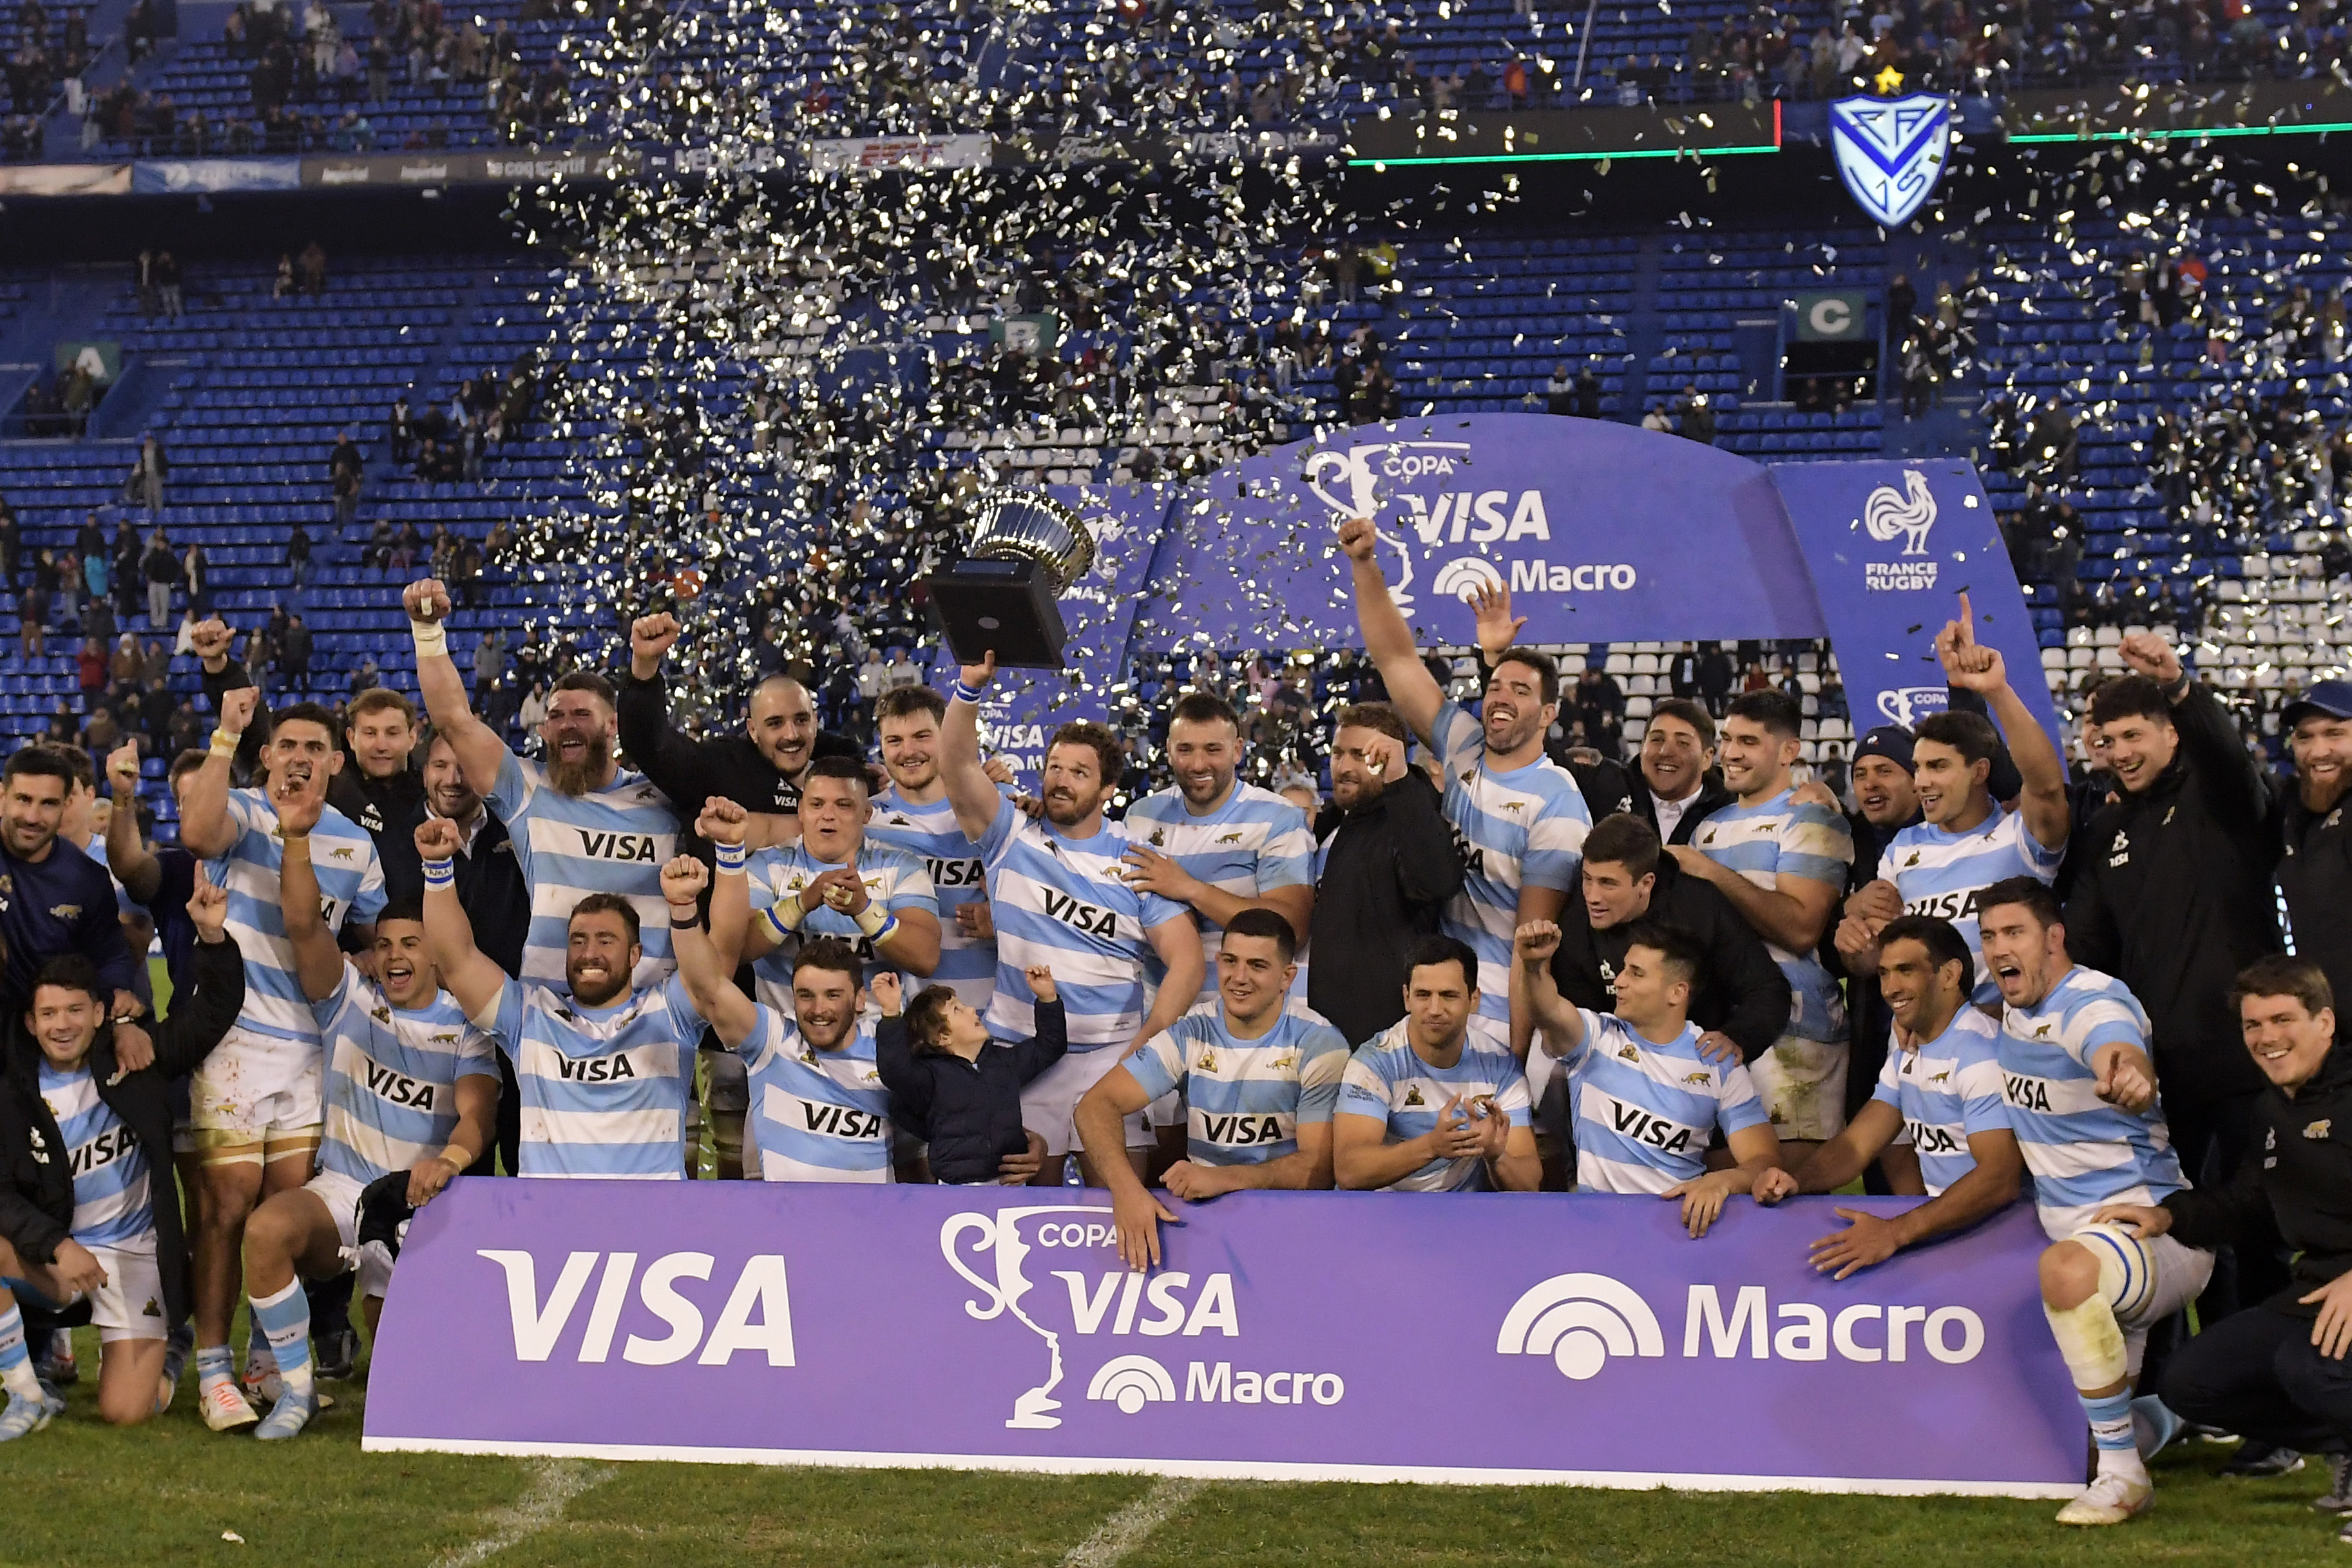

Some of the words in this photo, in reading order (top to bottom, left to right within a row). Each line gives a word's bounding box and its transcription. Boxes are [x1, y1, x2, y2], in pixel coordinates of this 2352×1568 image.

[1810, 298, 1851, 334] C
[75, 347, 108, 379] A
[1383, 455, 1453, 477] COPA
[1396, 490, 1551, 543] VISA
[1509, 559, 1637, 592] Macro
[1865, 562, 1938, 576] FRANCE
[1866, 575, 1937, 591] RUGBY
[1913, 693, 1948, 705] COPA
[774, 794, 798, 808] VISA
[359, 814, 383, 832] VISA
[575, 828, 657, 863] VISA
[1039, 885, 1118, 938] VISA
[365, 1055, 435, 1112] VISA
[554, 1049, 635, 1083] VISA
[2003, 1073, 2052, 1112] VISA
[798, 1100, 882, 1139] VISA
[1201, 1112, 1283, 1144] VISA
[1609, 1098, 1694, 1154] VISA
[475, 1249, 796, 1367] VISA
[1050, 1270, 1239, 1337] VISA
[1683, 1284, 1985, 1364] Macro
[1185, 1361, 1344, 1406] Macro
